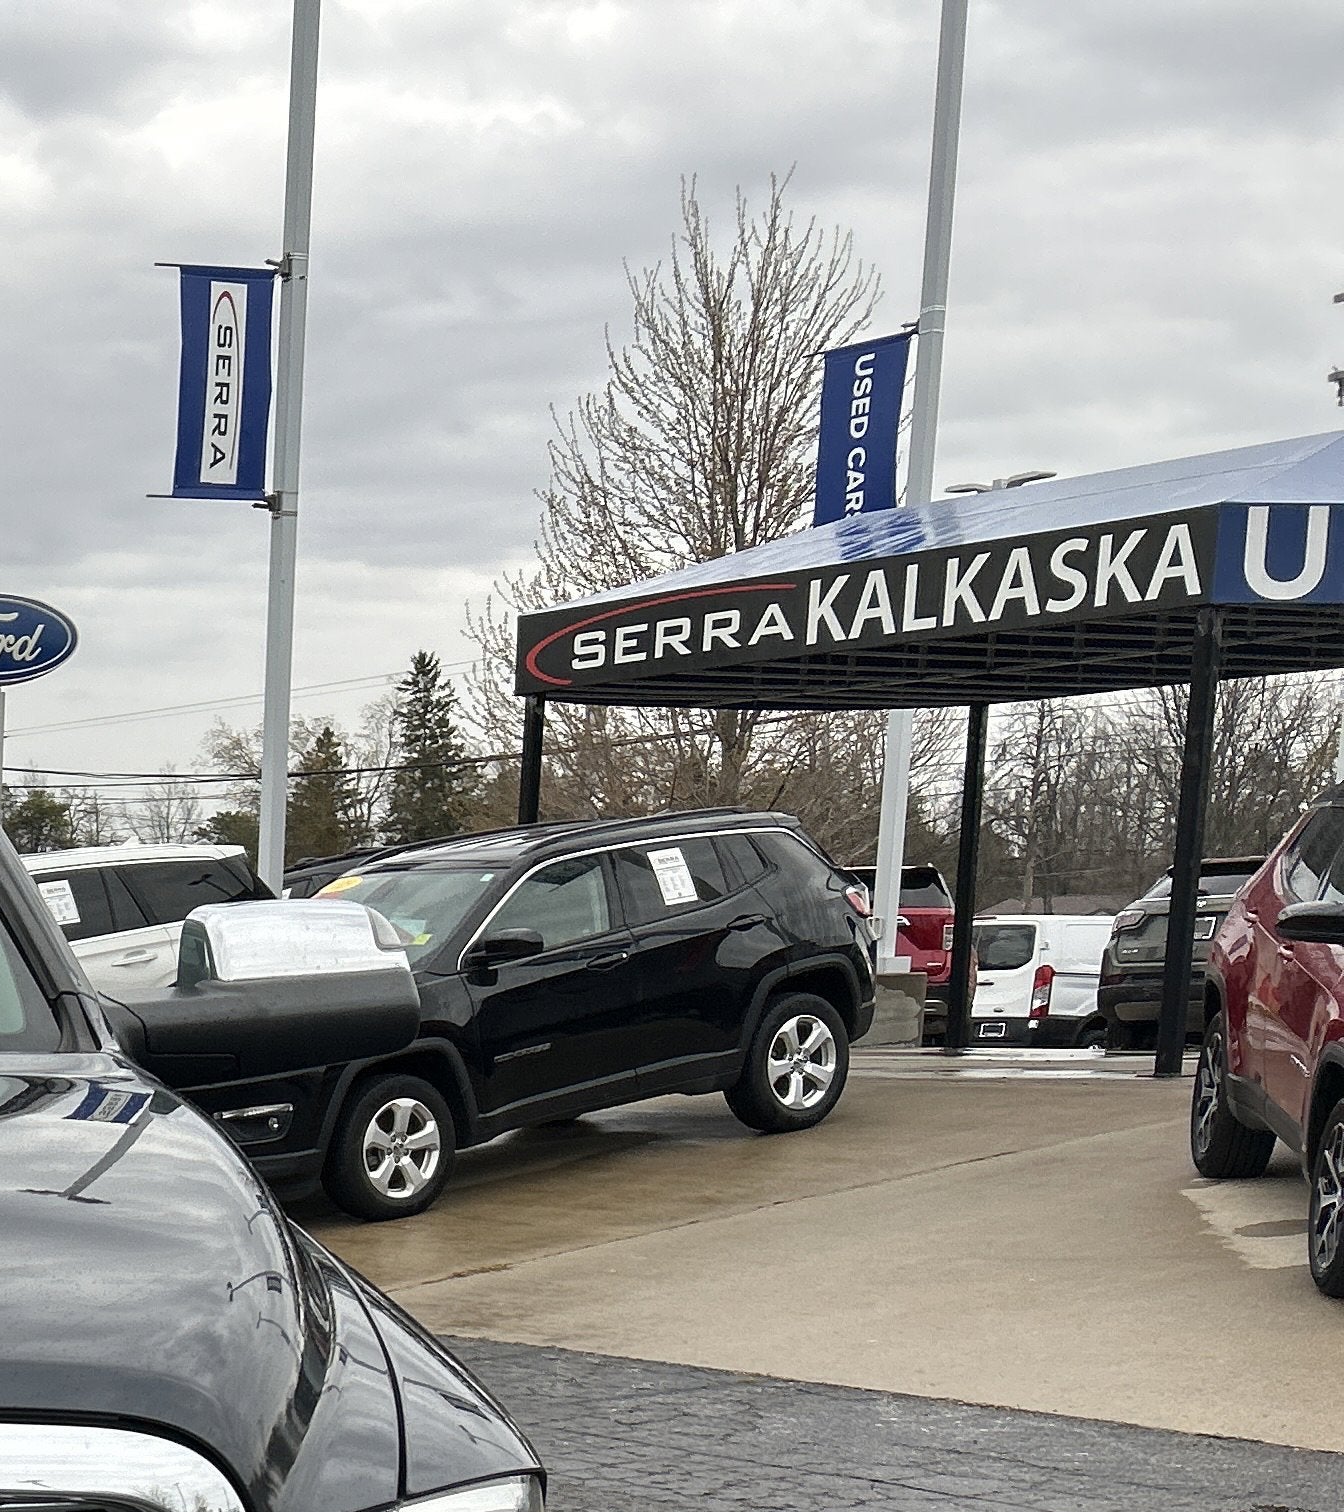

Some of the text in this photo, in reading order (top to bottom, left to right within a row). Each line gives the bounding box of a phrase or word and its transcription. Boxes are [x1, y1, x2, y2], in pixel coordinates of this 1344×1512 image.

[209, 324, 233, 469] SERRA
[844, 352, 876, 517] USED CAR
[570, 523, 1203, 671] SERRA KALKASKA
